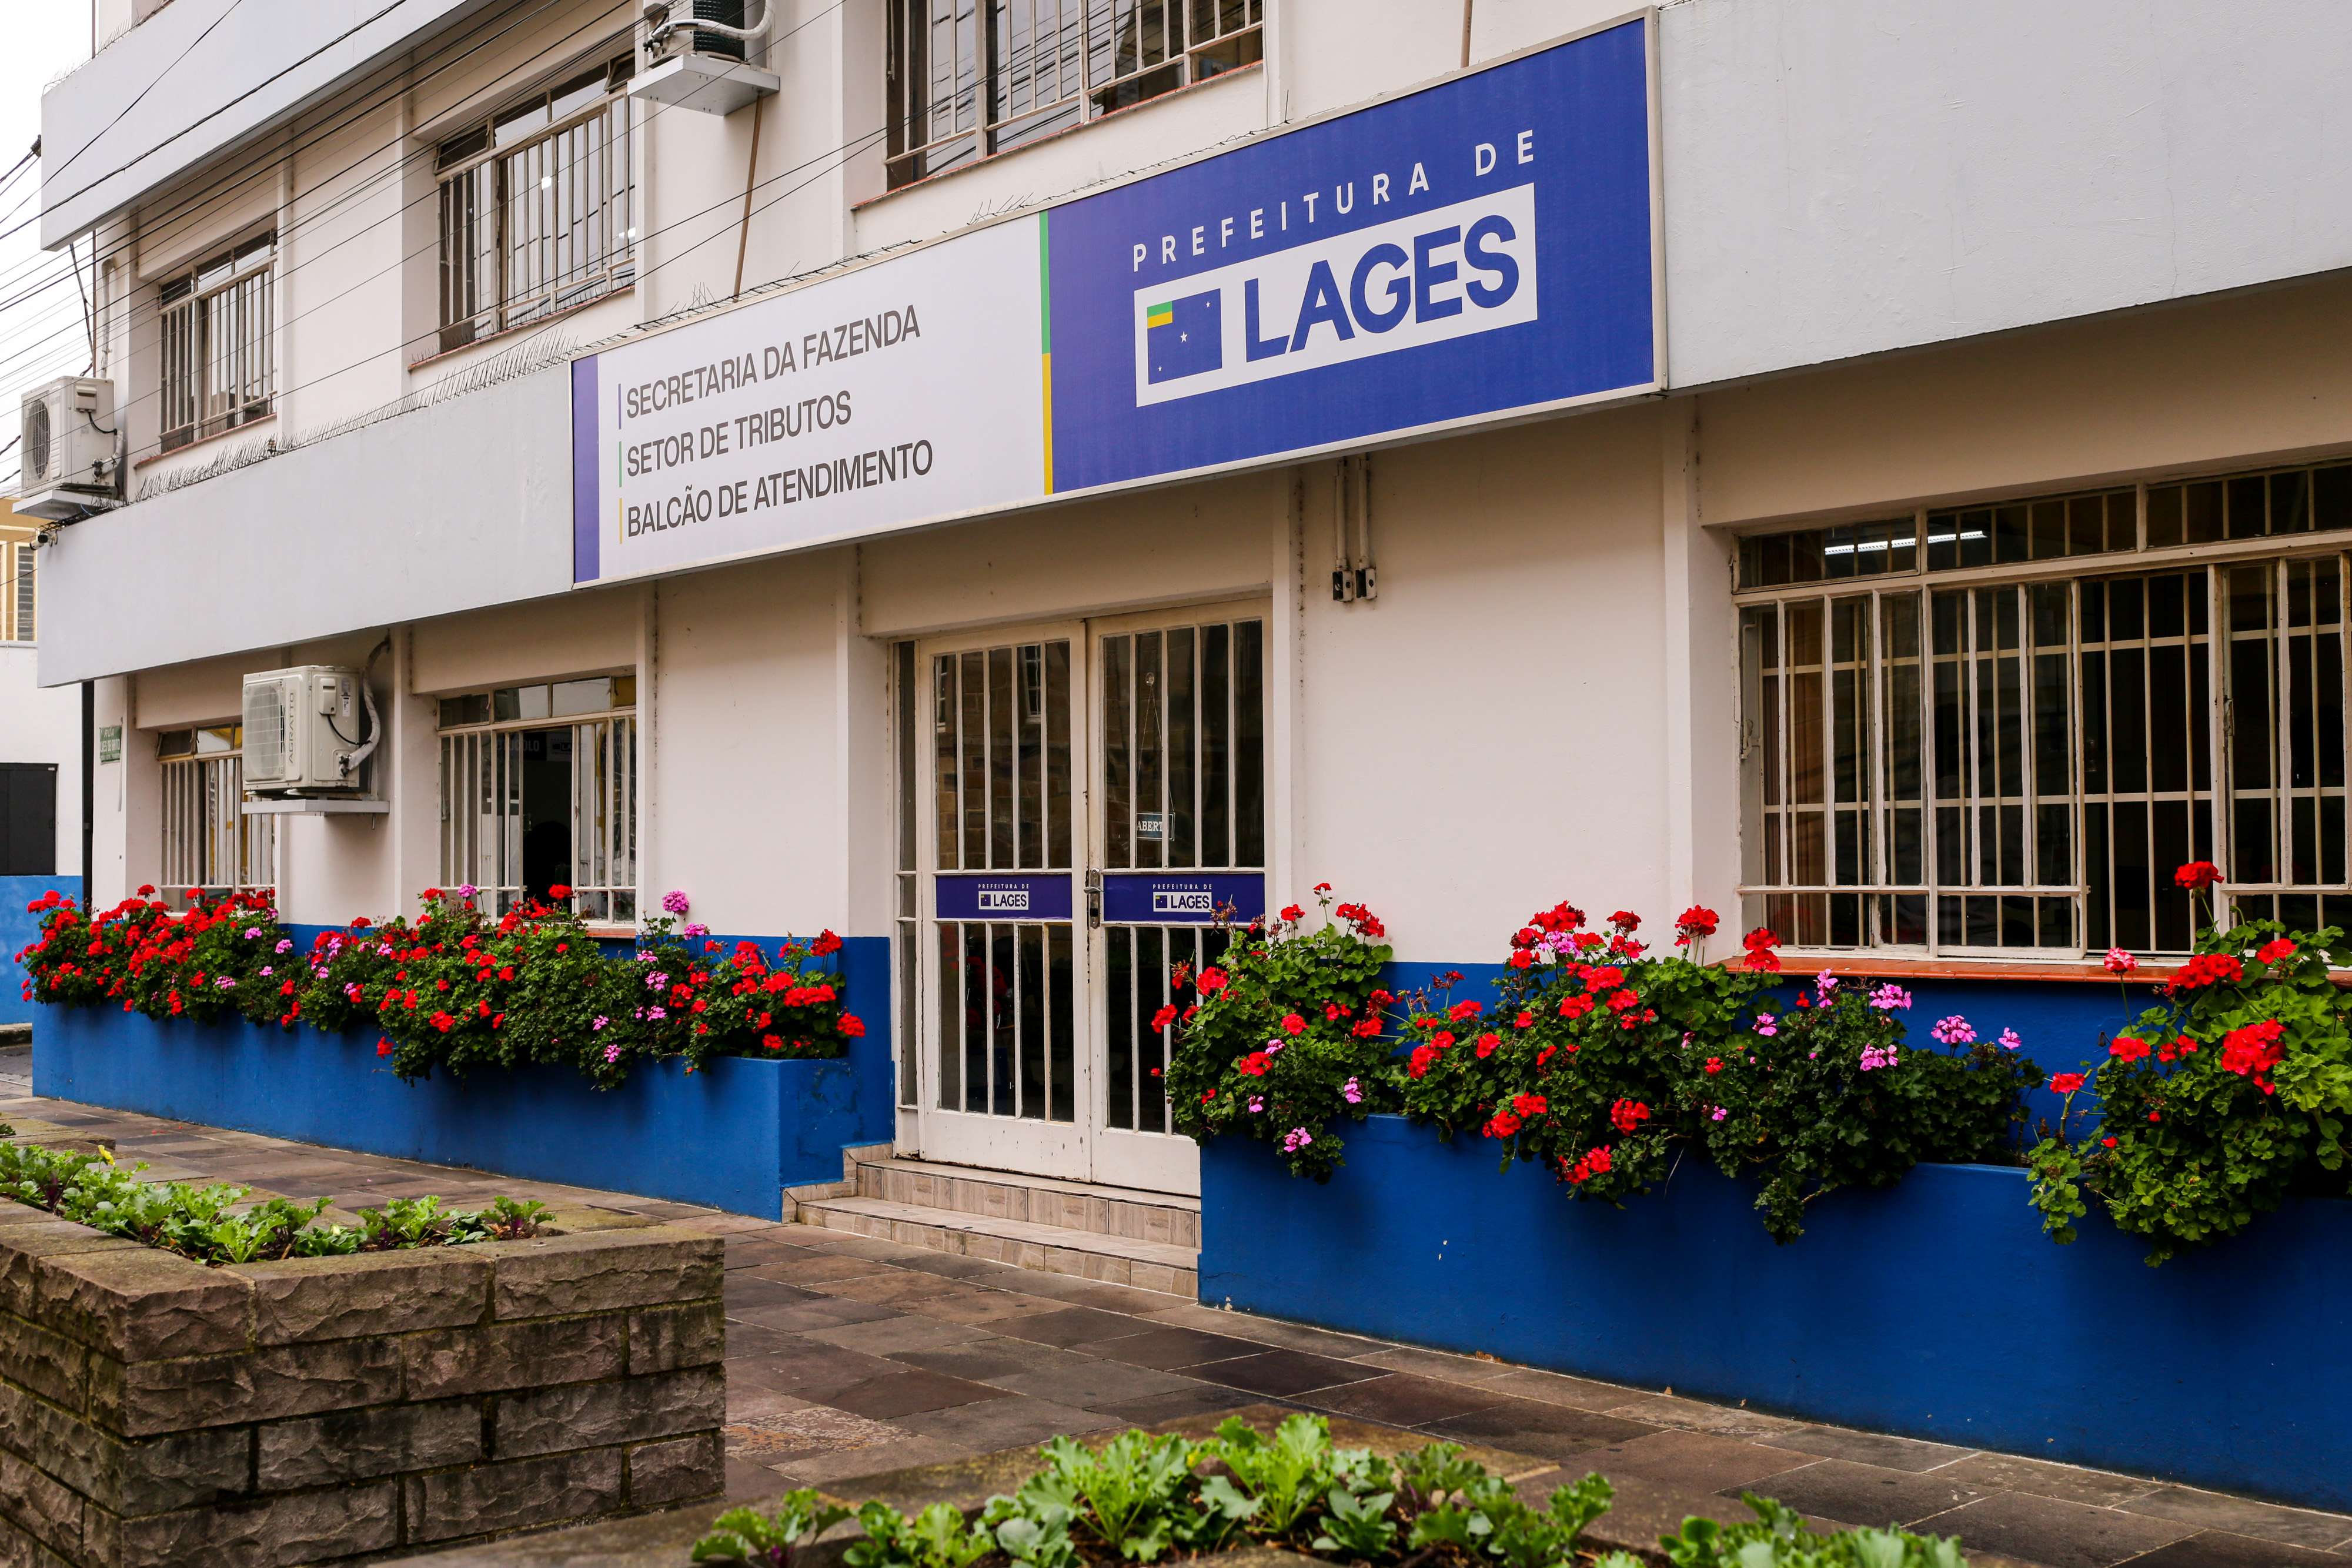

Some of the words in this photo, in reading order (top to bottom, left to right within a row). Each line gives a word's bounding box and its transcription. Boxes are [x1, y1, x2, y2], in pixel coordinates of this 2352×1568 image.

[1132, 162, 1429, 273] PREFEITURA
[1475, 129, 1534, 176] DE
[1244, 215, 1519, 363] LAGES
[627, 353, 758, 419] SECRETARIA
[764, 341, 797, 380] DA
[803, 305, 921, 370] FAZENDA
[627, 432, 694, 477] SETOR
[700, 421, 729, 459] DE
[734, 390, 851, 450] TRIBUTOS
[628, 484, 712, 537] BALCÃO
[719, 480, 748, 518] DE
[753, 439, 933, 511] ATENDIMENTO
[1137, 821, 1162, 832] ABERT
[994, 894, 1027, 907] LAGES
[1171, 895, 1210, 909] LAGES
